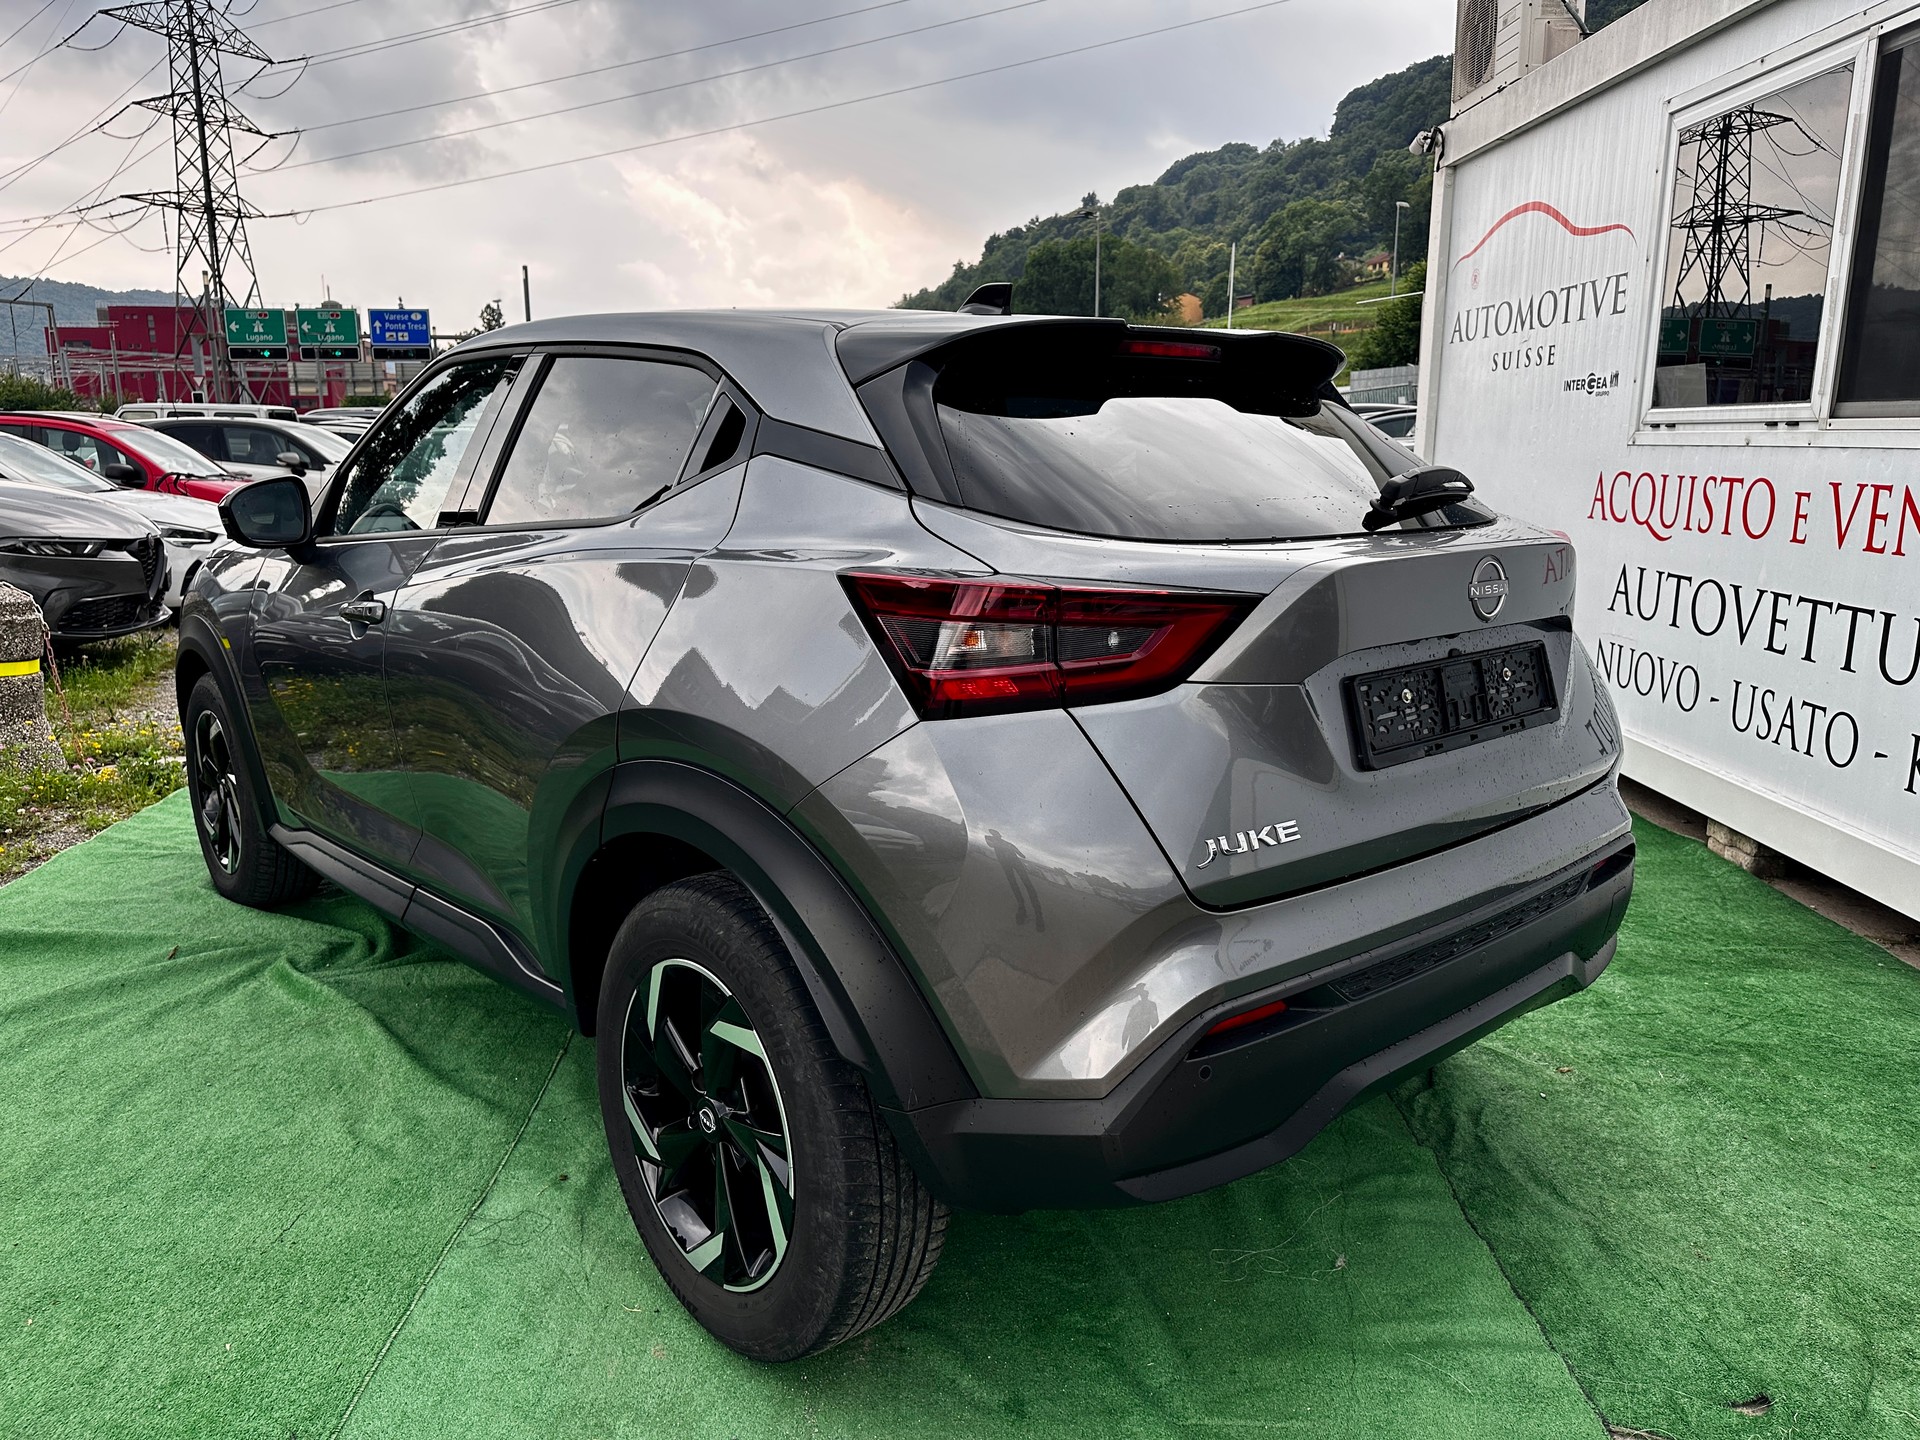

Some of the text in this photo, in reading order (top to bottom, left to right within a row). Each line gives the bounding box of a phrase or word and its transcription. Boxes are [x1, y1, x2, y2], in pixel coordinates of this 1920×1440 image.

[384, 312, 409, 321] Varese
[385, 322, 427, 331] Ponte Tresa
[1450, 272, 1629, 344] AUTOMOTIVE
[245, 333, 273, 342] Lugano
[317, 333, 345, 342] Lugano
[1491, 344, 1556, 372] SUISSE
[1587, 470, 1920, 557] ACQUISTO E VEN
[1607, 563, 1920, 686] AUTOVETTU
[1596, 637, 1700, 713] NUOVO
[1731, 679, 1859, 769] USATO
[1196, 819, 1302, 870] JUKE
